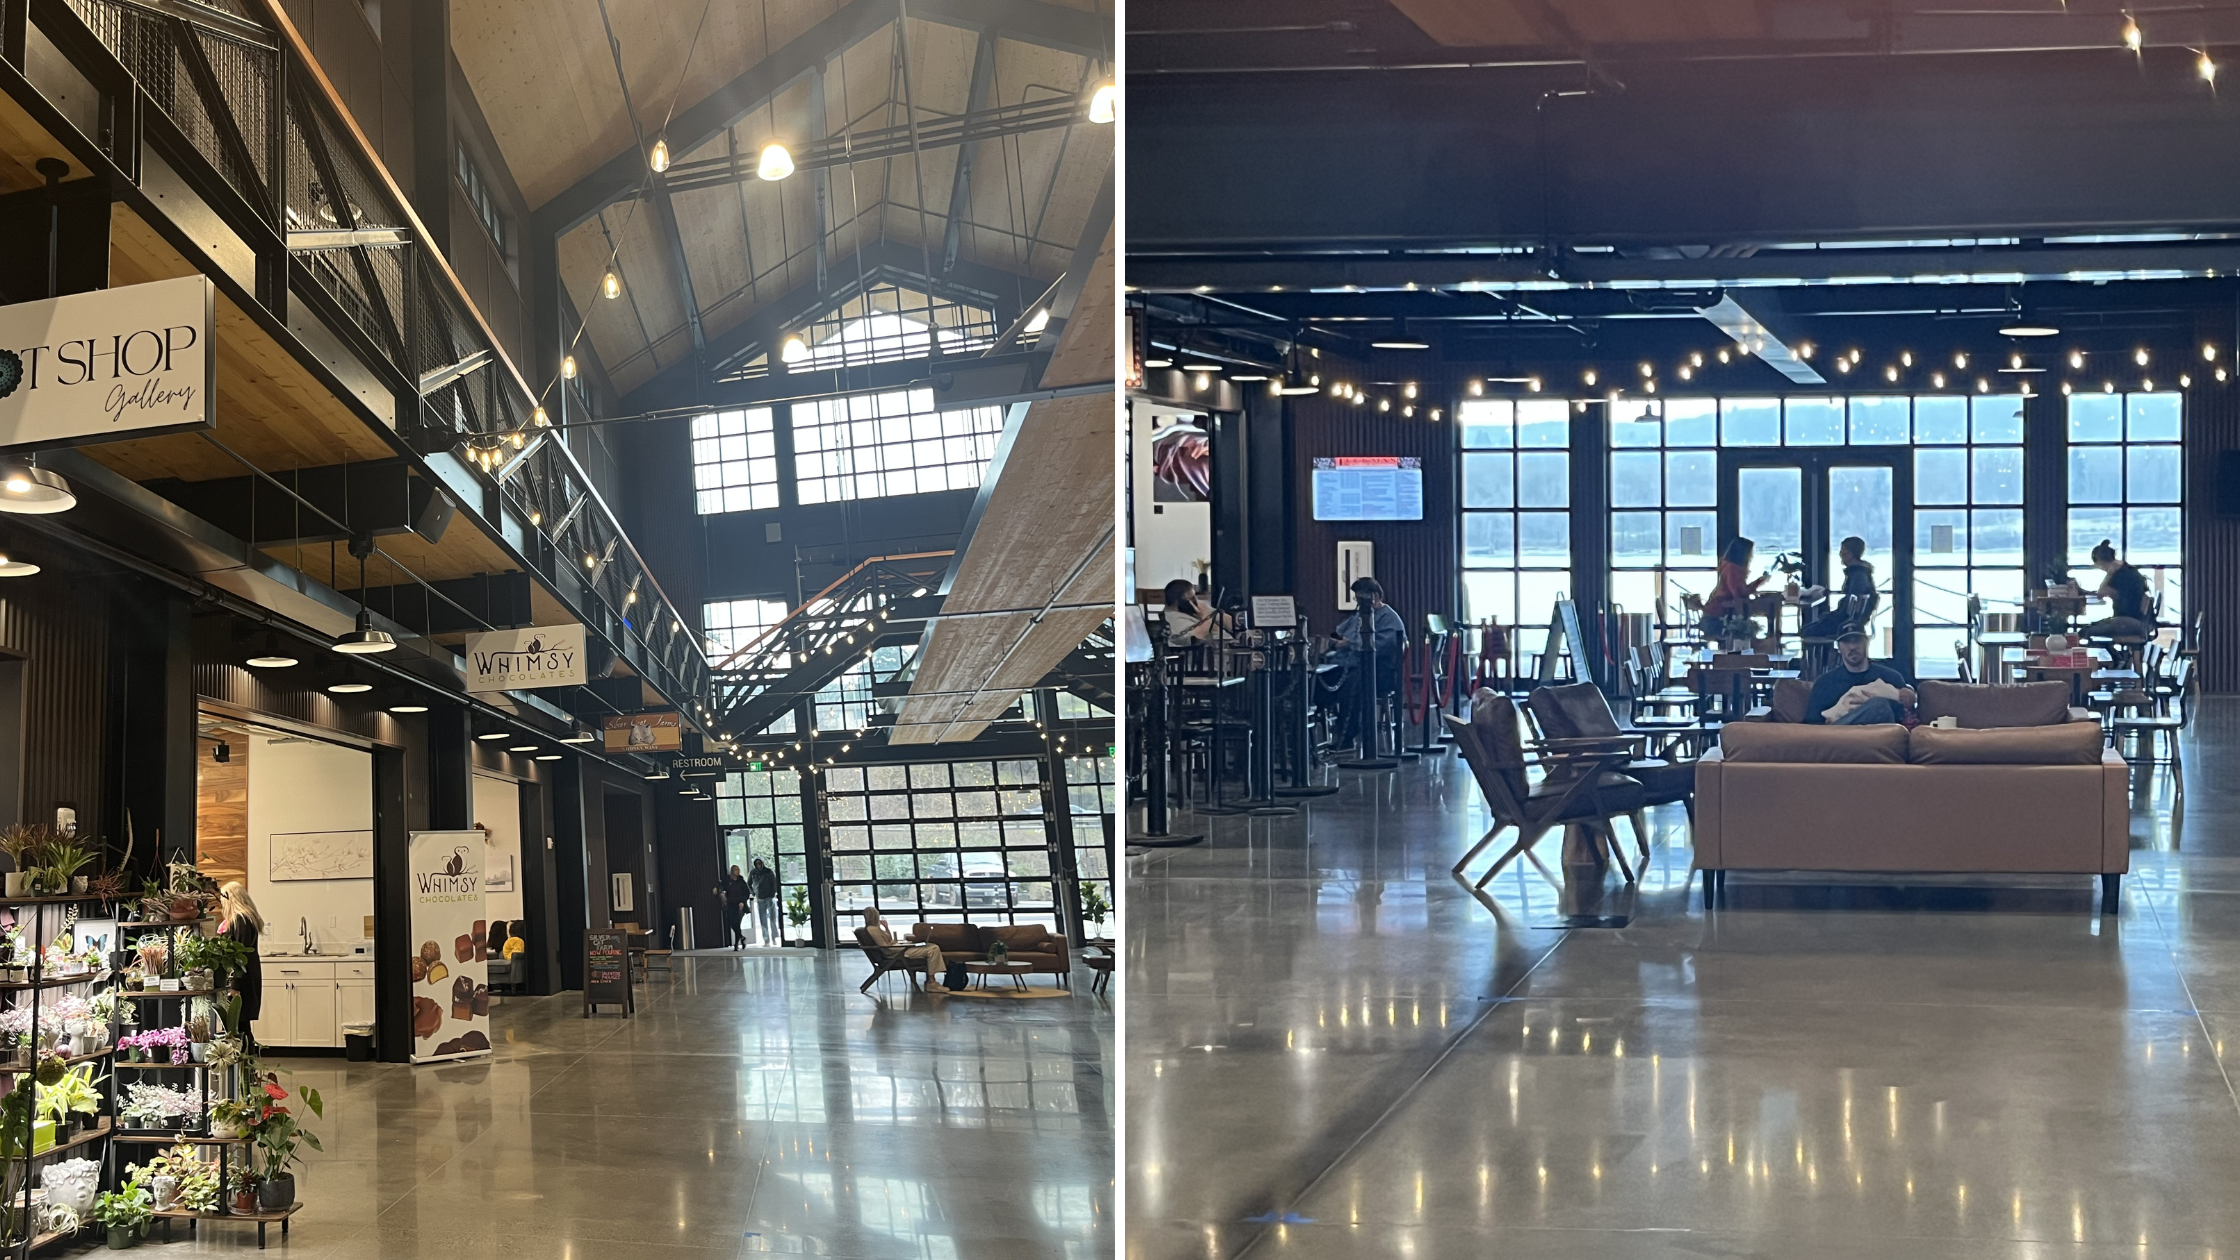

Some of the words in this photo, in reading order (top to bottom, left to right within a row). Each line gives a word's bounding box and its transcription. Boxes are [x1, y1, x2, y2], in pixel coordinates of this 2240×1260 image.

[57, 325, 197, 386] SHOP
[104, 378, 196, 422] Gallery
[474, 651, 574, 675] WHIMSY
[478, 669, 575, 683] CHOCOLATES
[672, 757, 722, 768] RESTROOM
[417, 872, 478, 894] WHIMSY
[419, 894, 479, 904] CHOCOLATES
